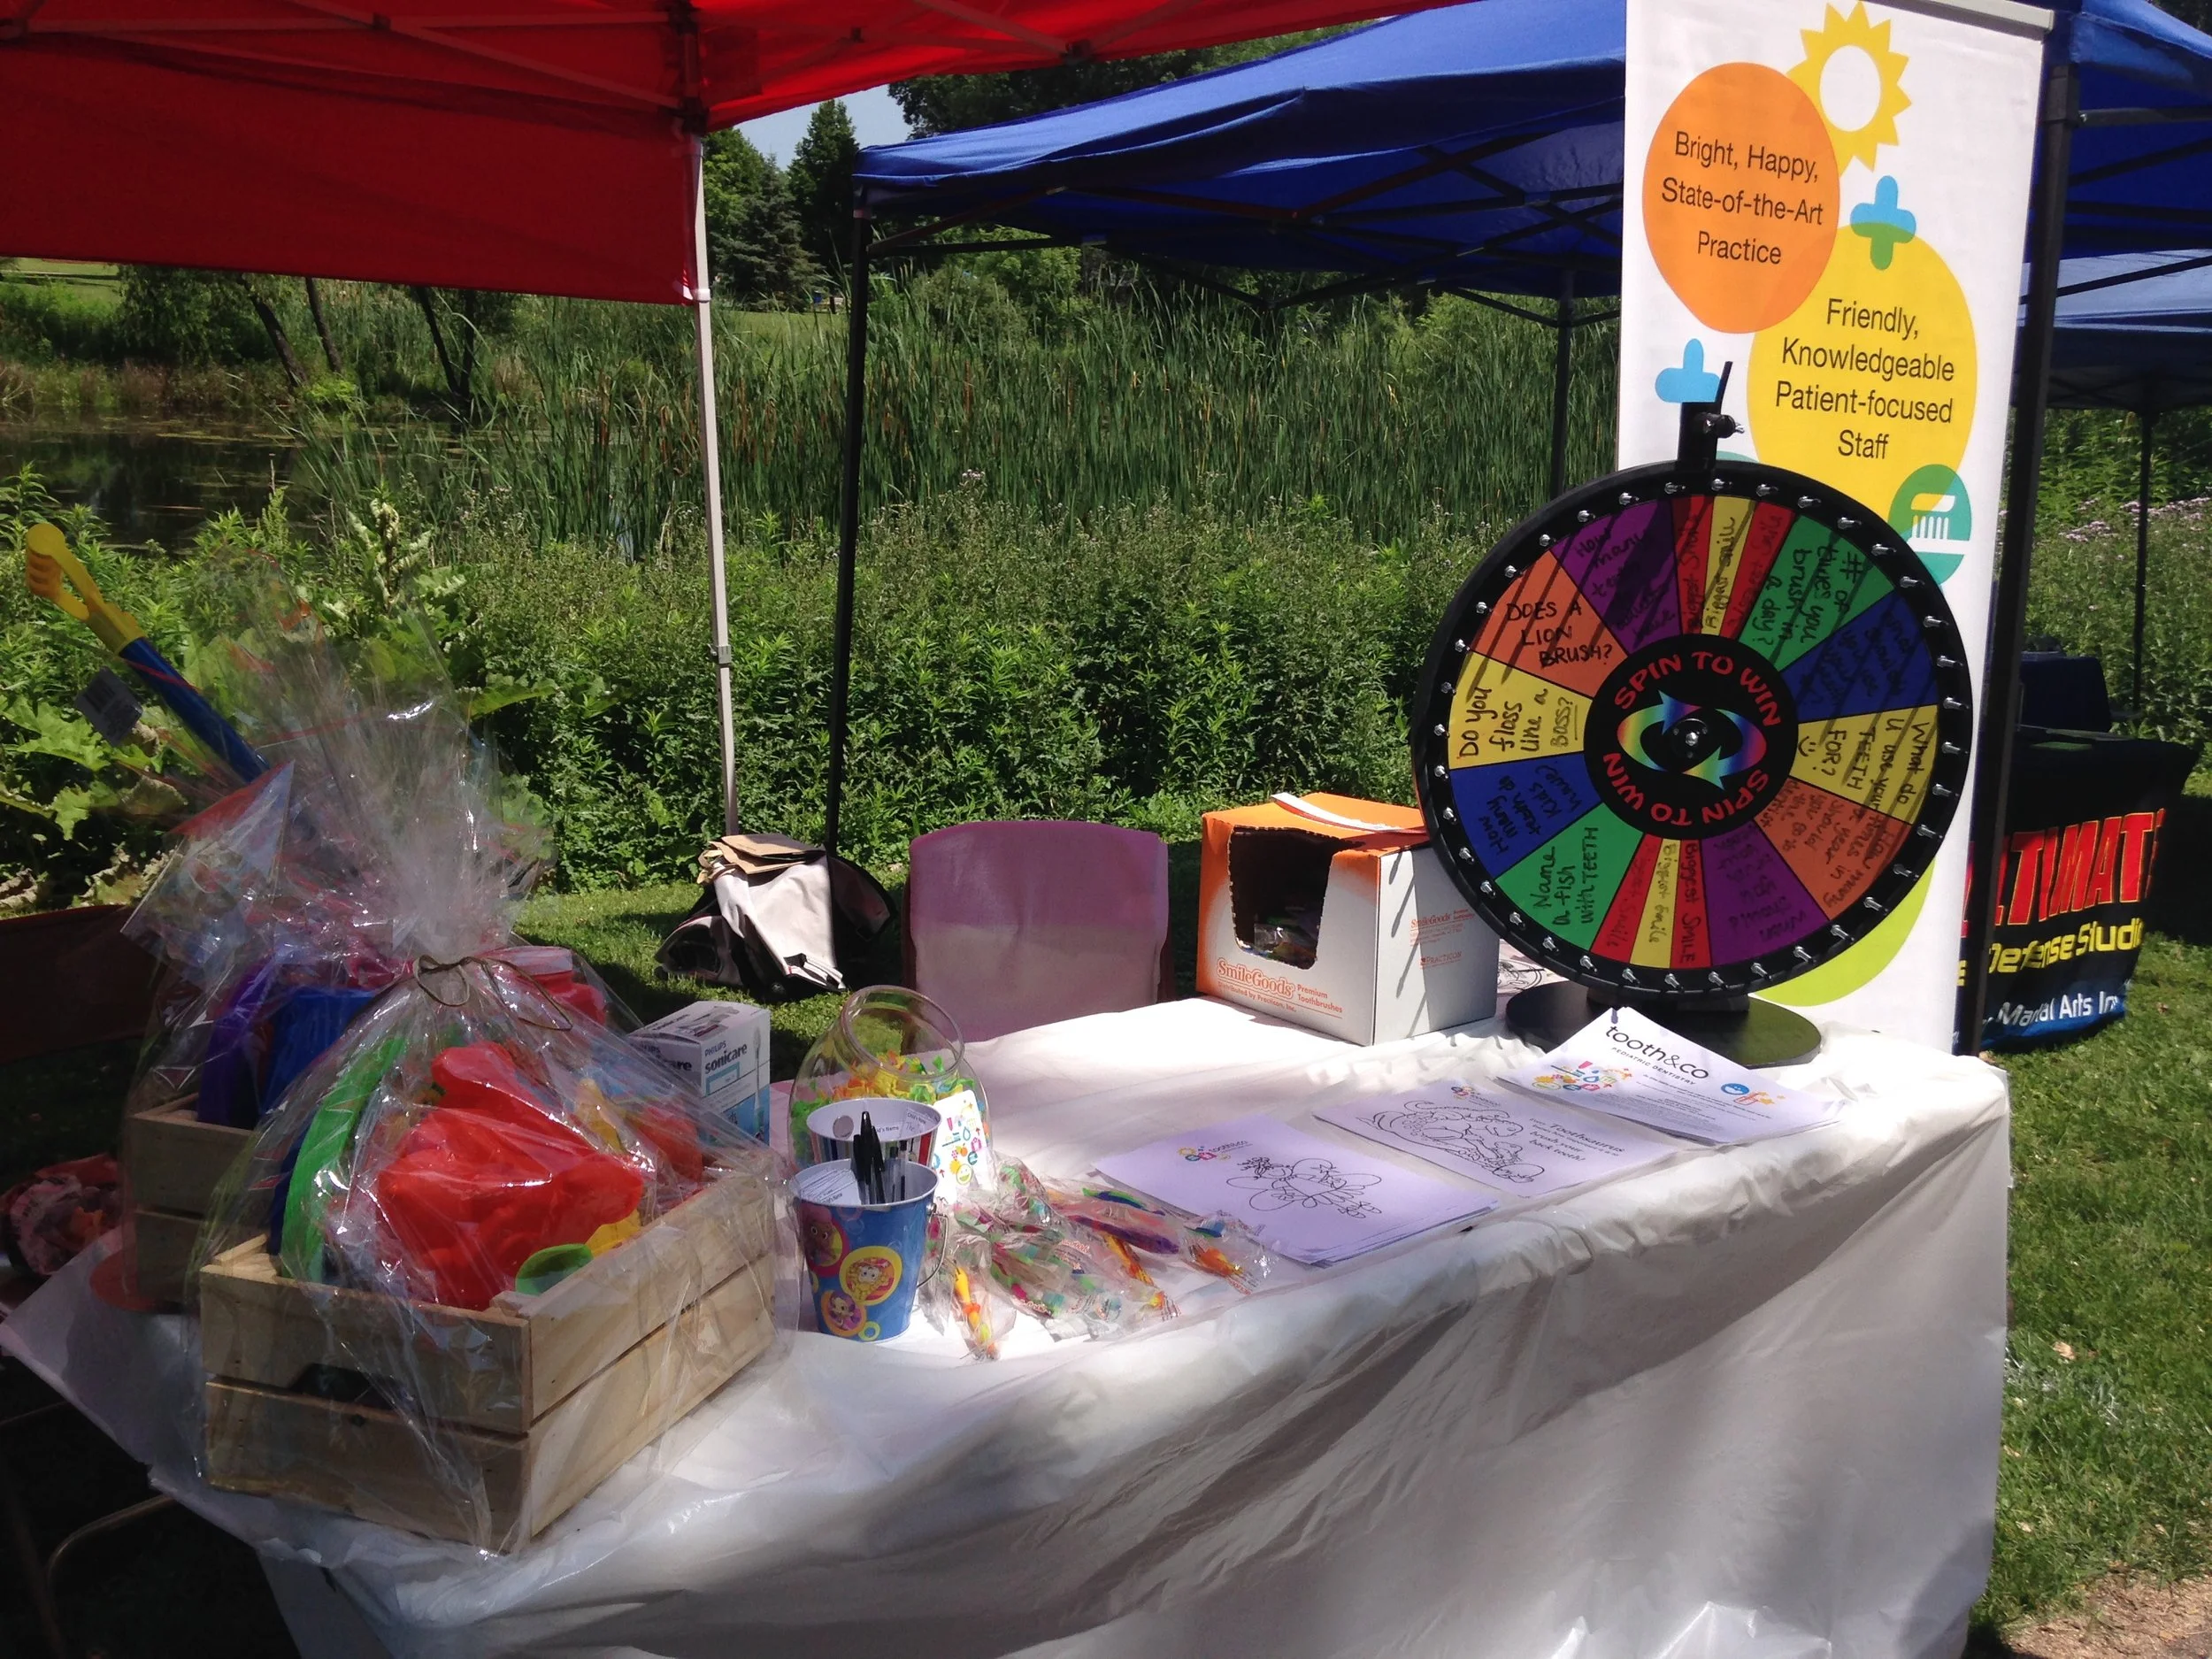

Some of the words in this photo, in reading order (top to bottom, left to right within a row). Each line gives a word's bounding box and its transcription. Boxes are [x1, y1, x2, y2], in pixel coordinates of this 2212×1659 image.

[1674, 131, 1739, 170] Bright,
[1747, 144, 1819, 182] Happy,
[1661, 177, 1824, 226] State-of-the-Art
[1697, 231, 1782, 265] Practice
[1826, 297, 1919, 340] Friendly,
[1781, 337, 1955, 382] Knowledgeable
[1775, 380, 1954, 424] Patient-focused
[1838, 430, 1890, 459] Staff
[1786, 549, 1813, 611] brush
[1506, 602, 1558, 621] DOES
[1569, 599, 1583, 617] A
[1521, 626, 1573, 646] LION
[1539, 644, 1613, 669] BRUSH?
[1464, 687, 1499, 724] you
[1614, 654, 1682, 710] SPIN
[1691, 651, 1734, 675] TO
[1740, 667, 1781, 726] WIN
[1488, 701, 1523, 752] floss
[1602, 753, 1645, 810] WIN
[1651, 803, 1694, 826] TO
[1701, 770, 1770, 825] SPIN
[1581, 826, 1599, 885] TEETH
[1993, 808, 2167, 927] LTIMAT
[1530, 845, 1556, 910] Name
[2076, 917, 2144, 956] Studi
[1217, 958, 1294, 999] SmileGoods
[1297, 984, 1328, 999] Premium
[1297, 994, 1343, 1013] Toothbrushes
[2058, 993, 2093, 1019] Arts
[704, 1040, 727, 1057] PHILIPS
[705, 1043, 748, 1075] sonicare
[1606, 1025, 1709, 1079] tooth&co
[1611, 1047, 1652, 1067] PEDIATRIC
[1652, 1065, 1696, 1086] DENTISTRY
